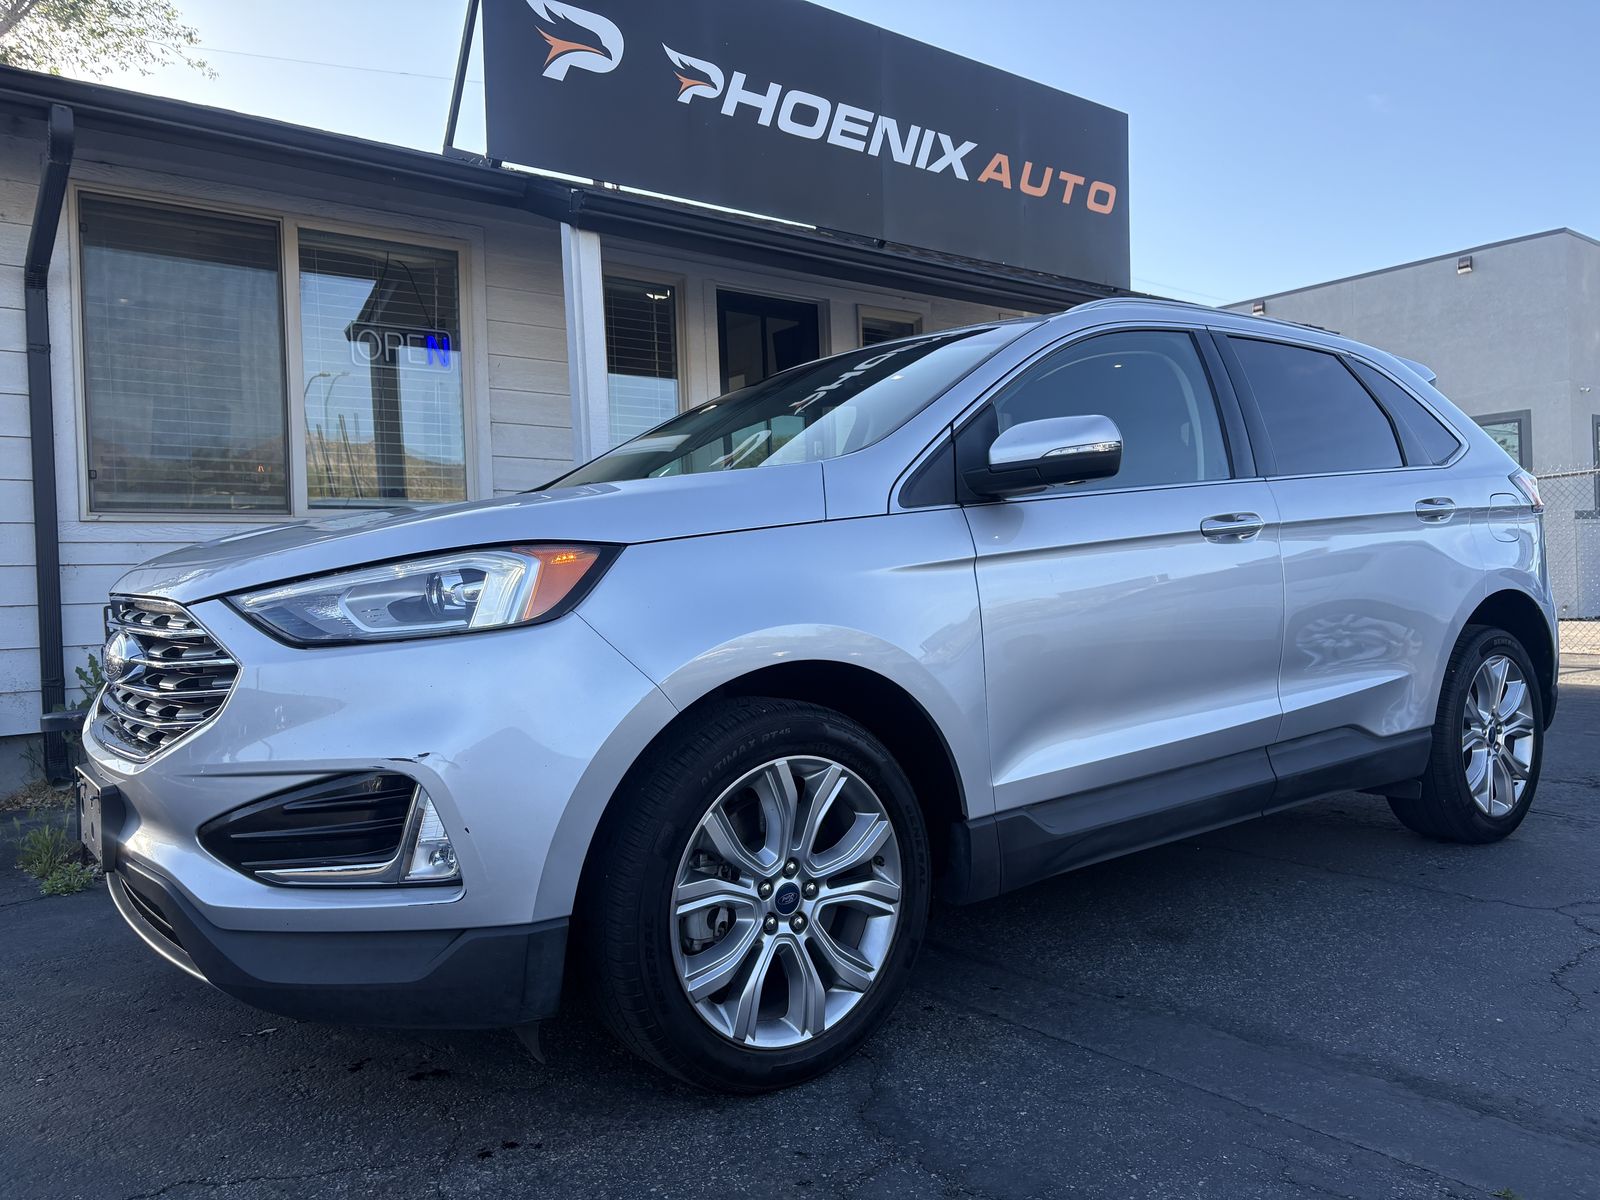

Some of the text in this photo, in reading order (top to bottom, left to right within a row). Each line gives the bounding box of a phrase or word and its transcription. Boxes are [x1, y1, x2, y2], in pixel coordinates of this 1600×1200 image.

[662, 42, 1117, 215] PHOENIX AUTO
[356, 329, 450, 368] OPEN
